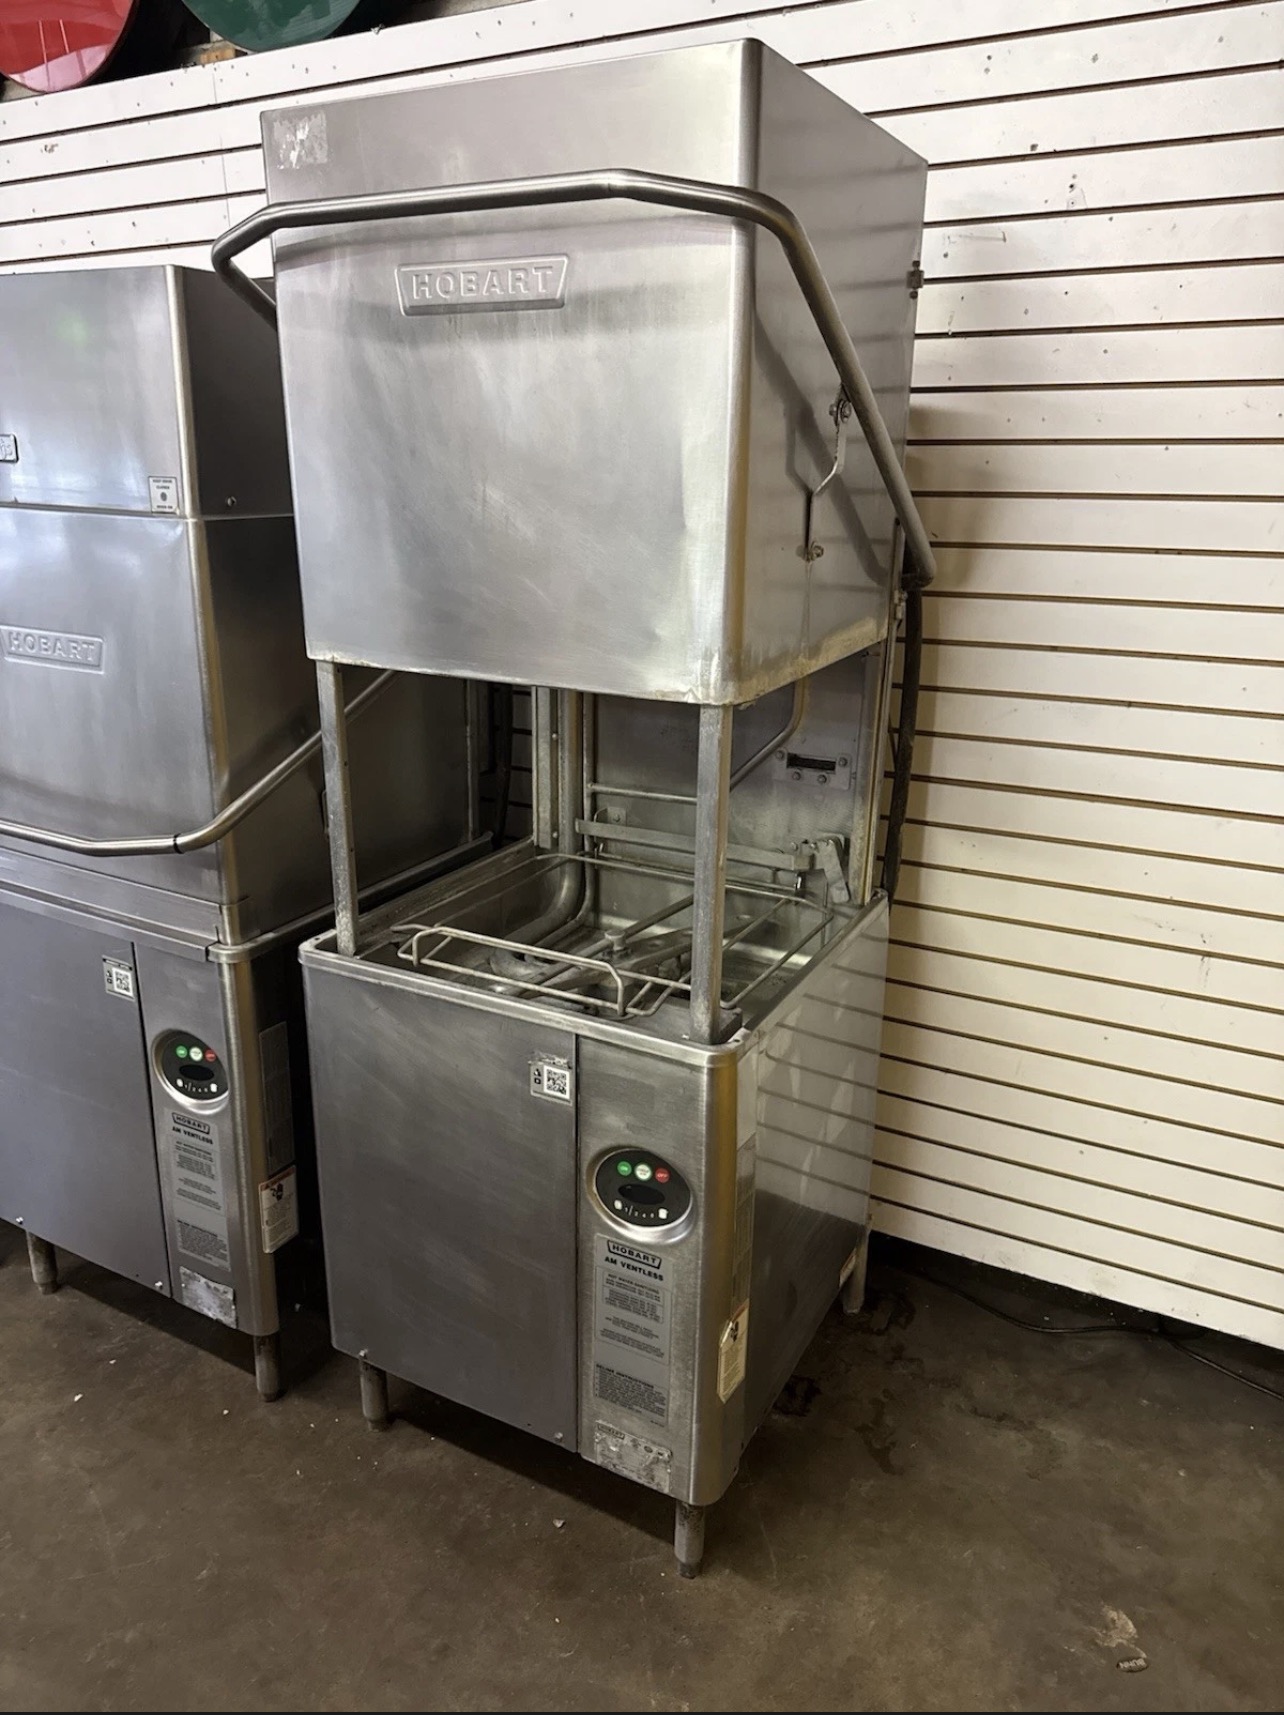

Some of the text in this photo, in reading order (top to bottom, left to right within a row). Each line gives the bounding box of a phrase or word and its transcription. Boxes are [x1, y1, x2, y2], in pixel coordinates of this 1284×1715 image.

[412, 265, 554, 300] HOBART
[8, 630, 96, 661] HOBART
[176, 1115, 206, 1130] HOBART
[612, 1244, 657, 1263] HOBART
[604, 1255, 664, 1282] AM VENTLESS
